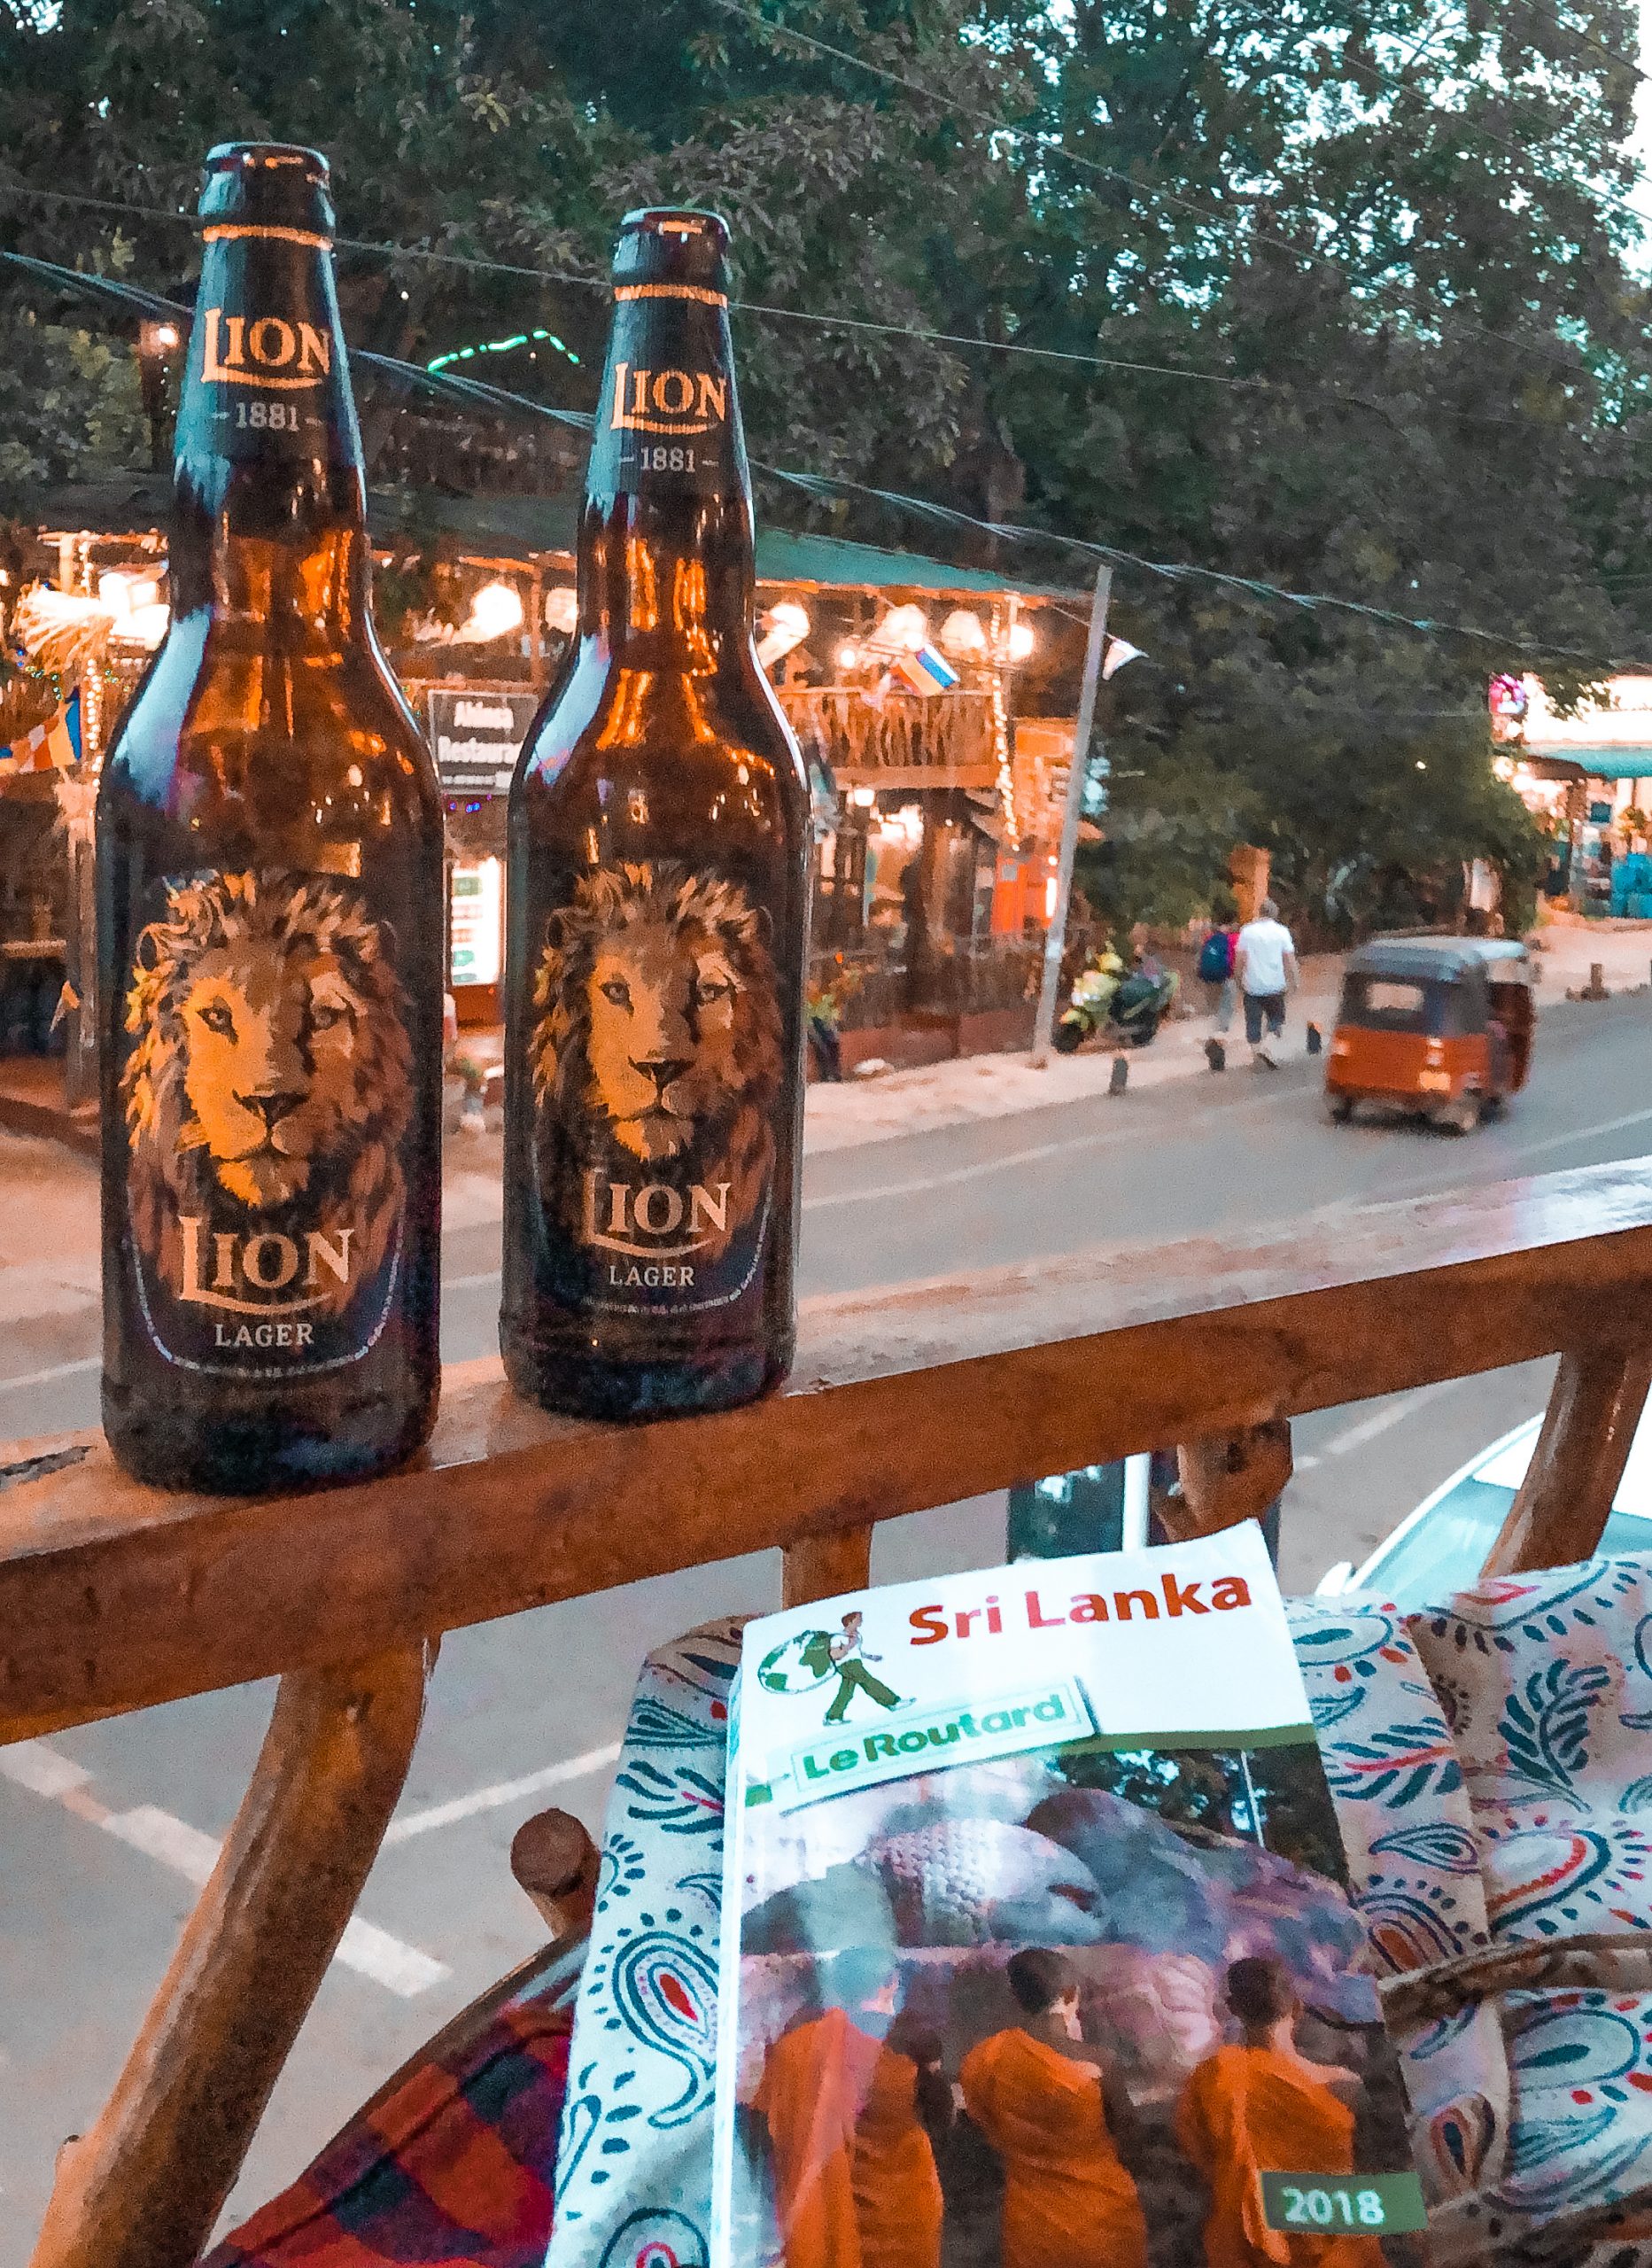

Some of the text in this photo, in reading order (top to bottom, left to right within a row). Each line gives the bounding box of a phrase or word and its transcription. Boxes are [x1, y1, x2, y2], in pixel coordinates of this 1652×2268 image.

[201, 307, 330, 390] LION
[236, 401, 299, 431] 1881
[610, 362, 726, 434] LION
[640, 446, 696, 472] 1881
[178, 1216, 354, 1315] LION
[609, 1265, 694, 1287] LAGER
[214, 1324, 314, 1348] LAGER
[909, 1573, 1252, 1645] Sri Lanka
[1281, 2186, 1384, 2225] 2018
